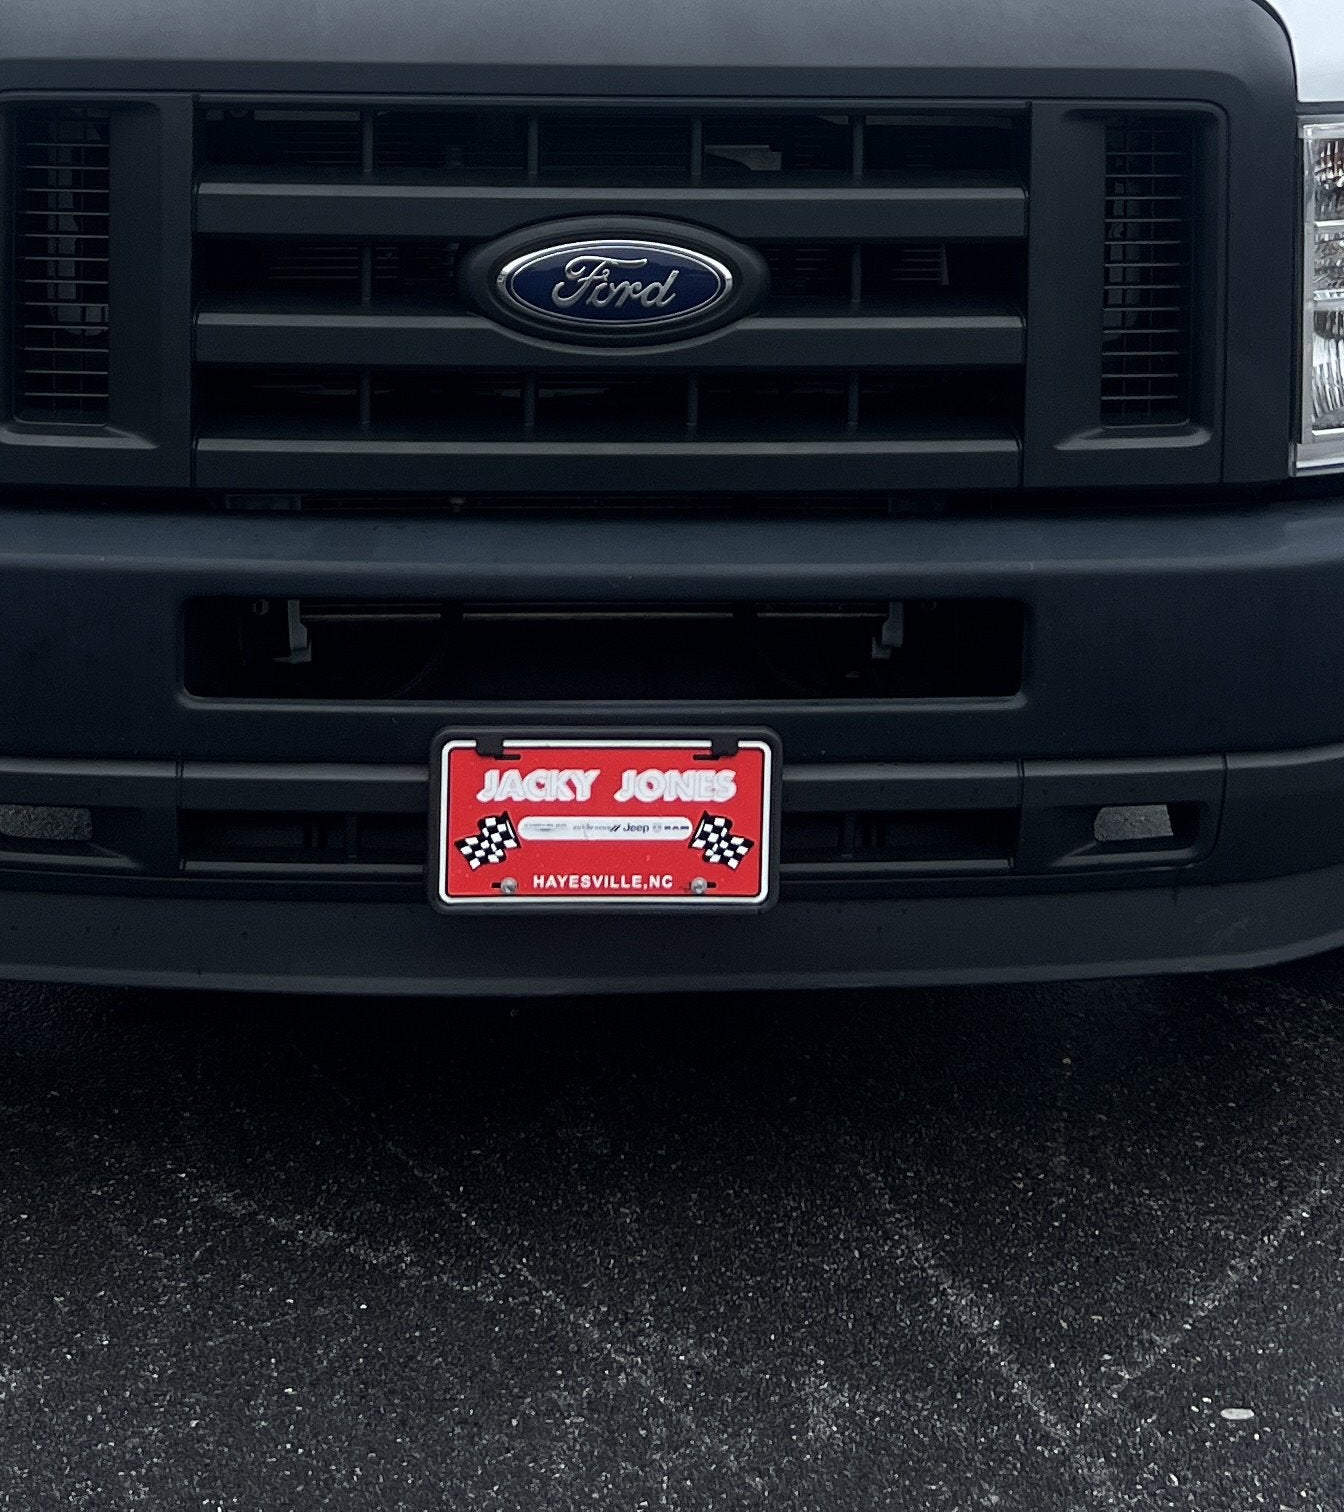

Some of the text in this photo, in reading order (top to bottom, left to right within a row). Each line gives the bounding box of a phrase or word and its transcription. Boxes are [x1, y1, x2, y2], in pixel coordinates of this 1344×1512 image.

[551, 255, 680, 308] Ford
[476, 769, 737, 803] JACKY JONES
[622, 822, 650, 834] Jeep
